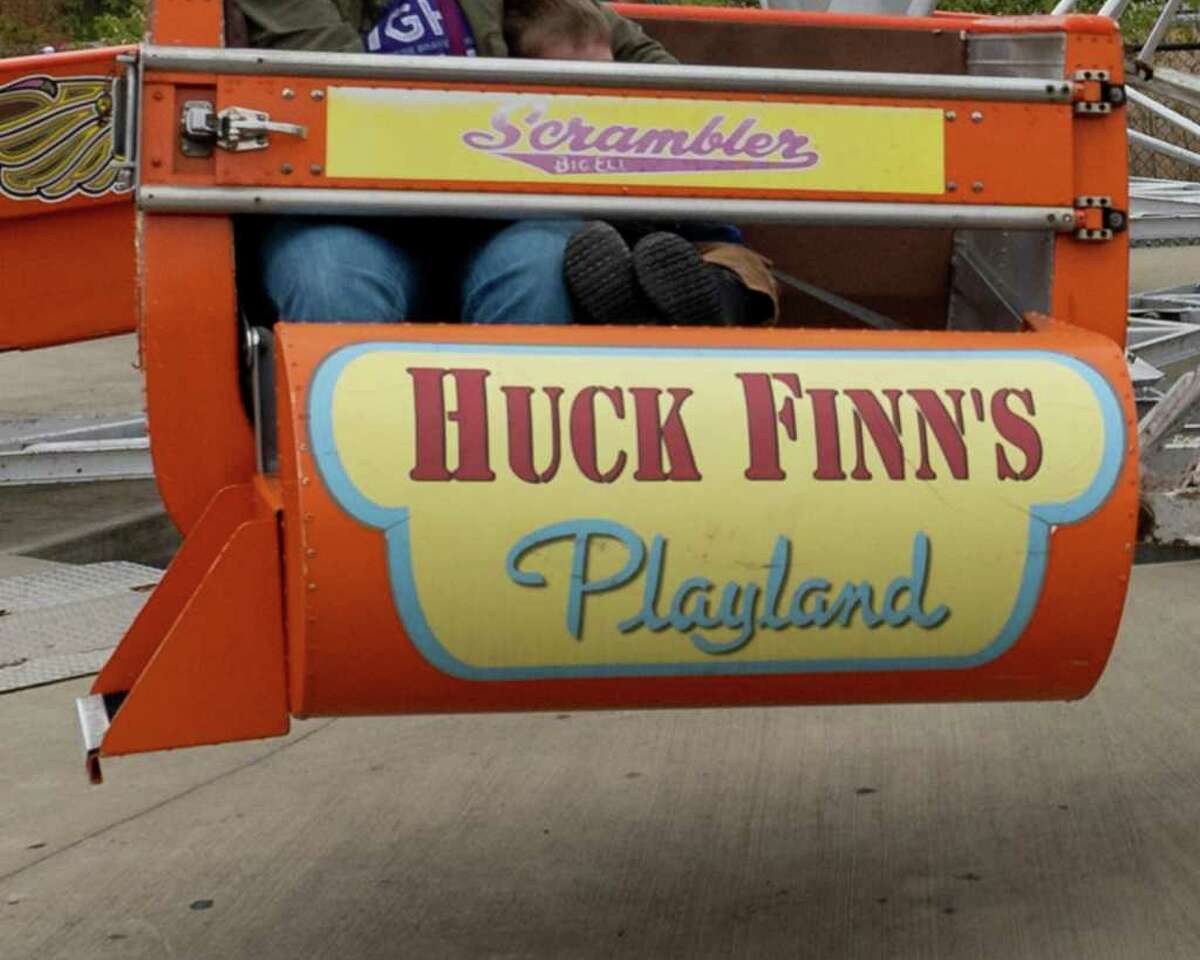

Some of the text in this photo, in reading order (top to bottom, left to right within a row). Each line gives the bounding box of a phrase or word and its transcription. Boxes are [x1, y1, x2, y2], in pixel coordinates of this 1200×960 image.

[462, 103, 819, 168] Scrambler
[406, 367, 1044, 483] HUCK FINN'S
[505, 517, 950, 655] Playland
